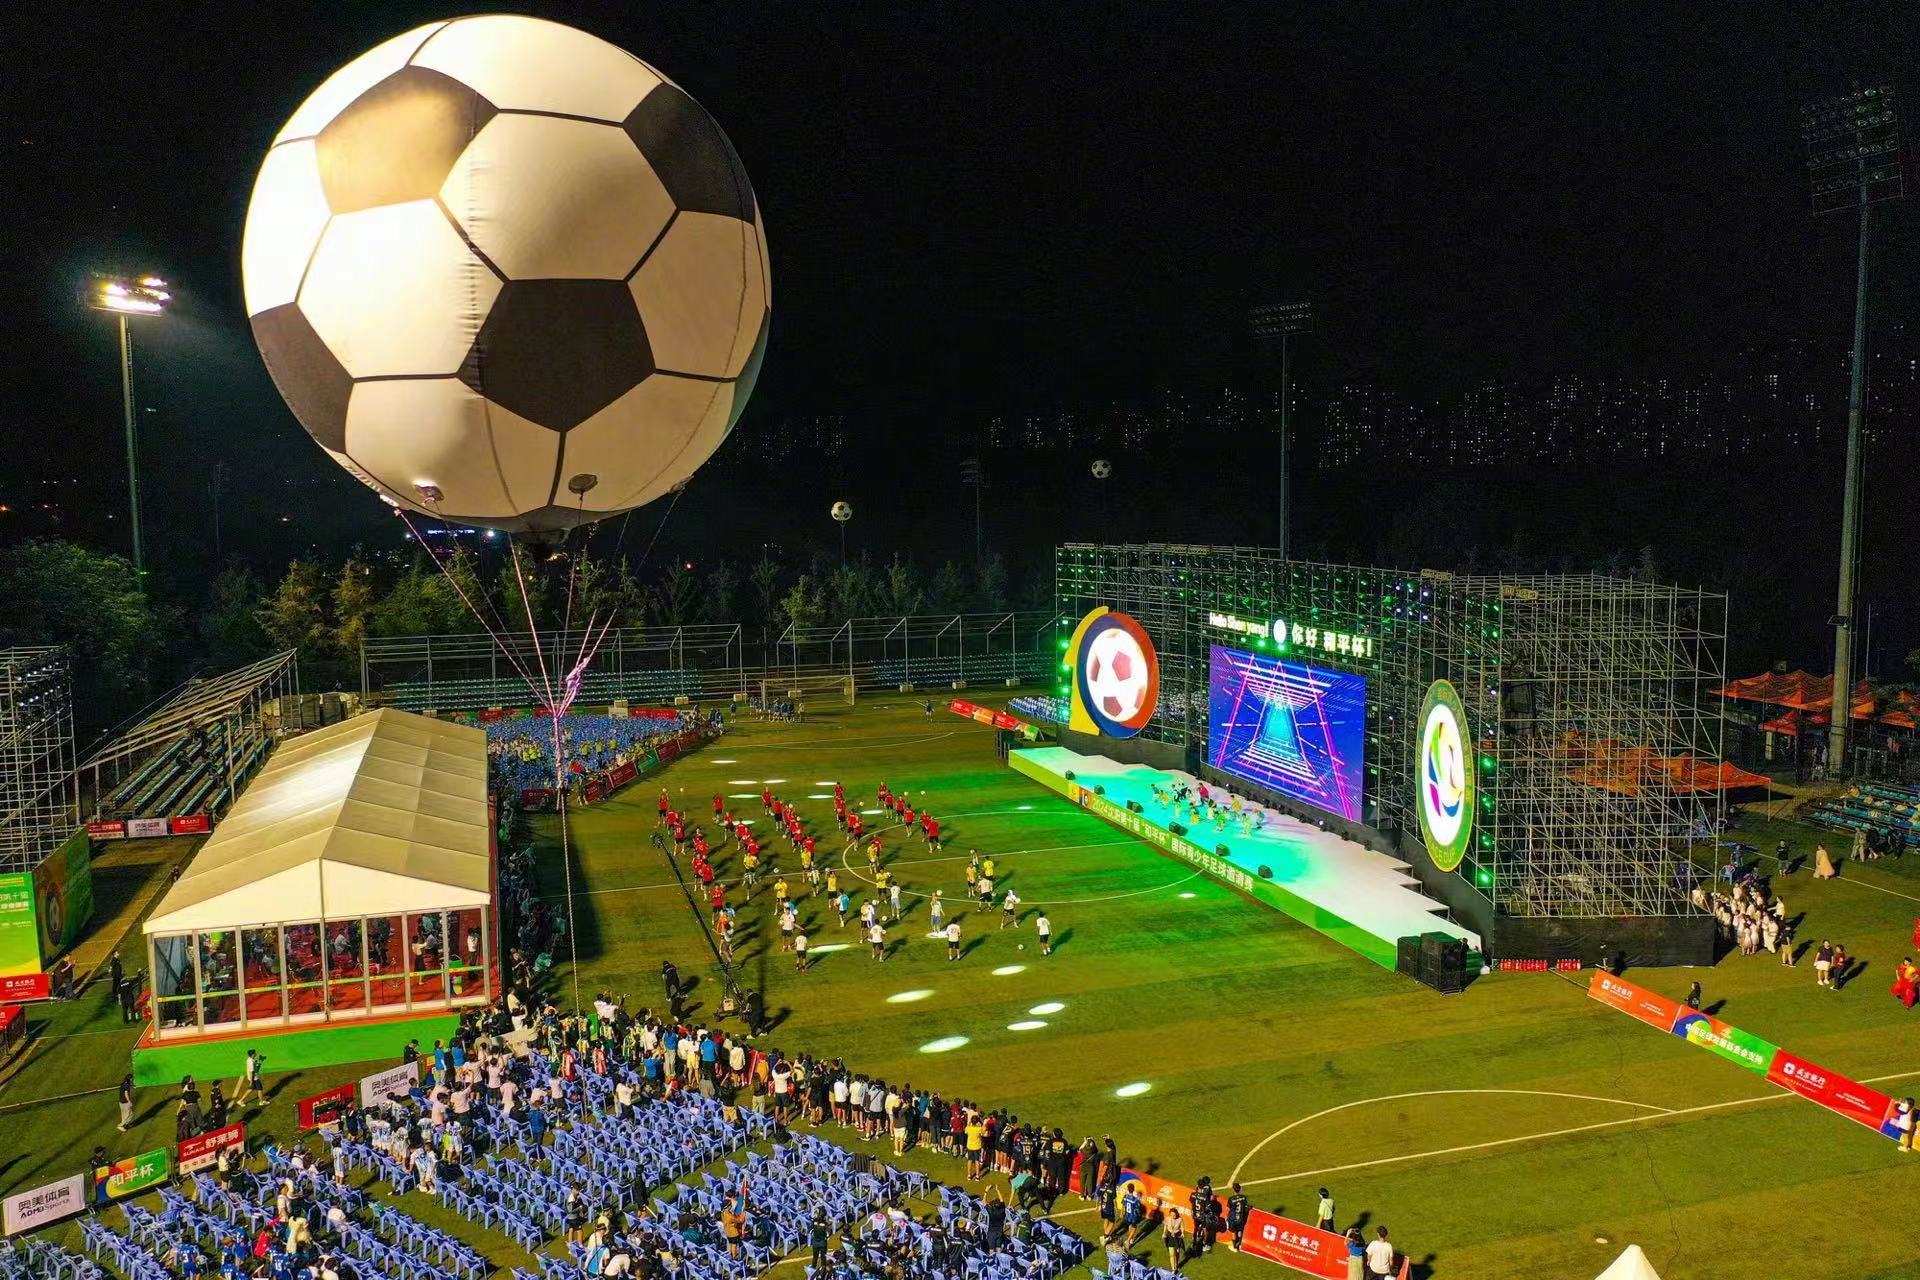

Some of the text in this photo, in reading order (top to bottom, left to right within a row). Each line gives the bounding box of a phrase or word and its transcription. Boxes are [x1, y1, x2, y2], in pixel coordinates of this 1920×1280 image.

[110, 1163, 154, 1186] 和平杯
[18, 1186, 70, 1212] 奥美体育
[1126, 1202, 1132, 1213] 8
